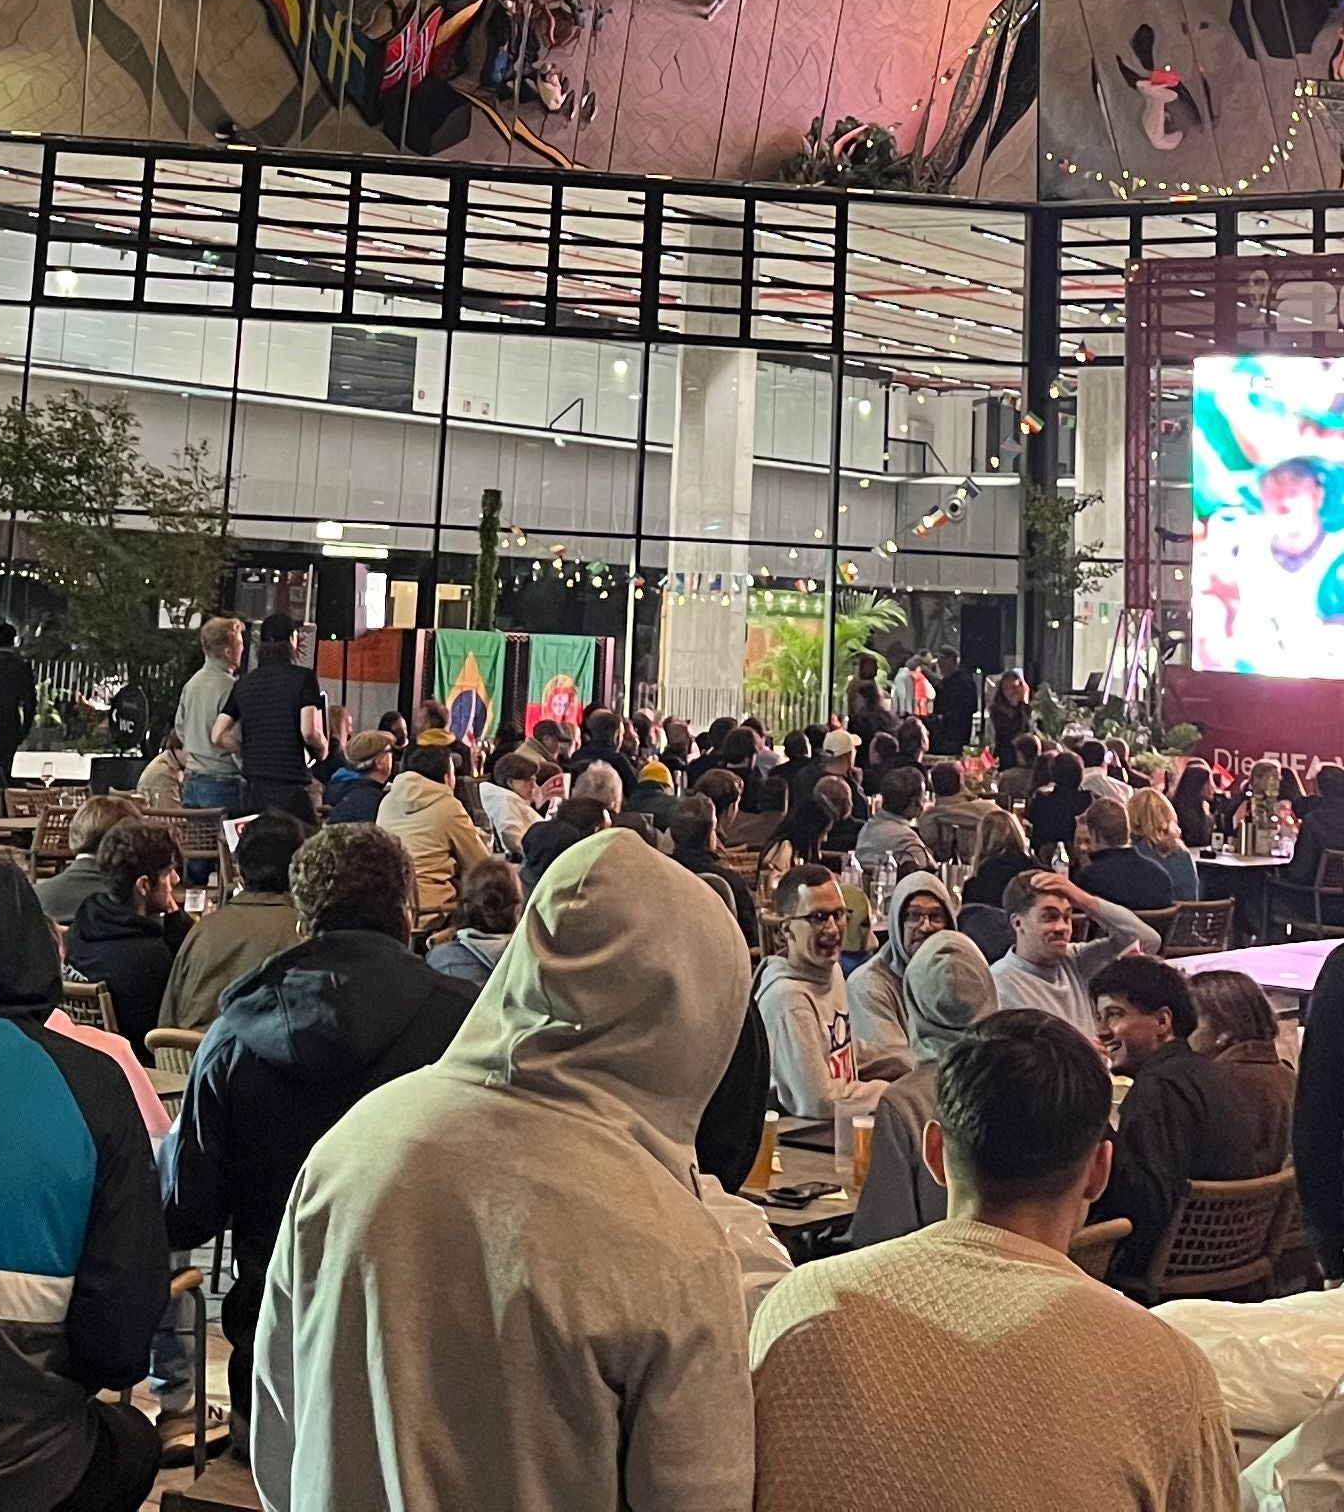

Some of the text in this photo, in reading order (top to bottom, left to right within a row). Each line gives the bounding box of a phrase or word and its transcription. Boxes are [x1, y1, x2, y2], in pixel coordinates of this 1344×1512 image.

[119, 718, 135, 734] WC
[1213, 748, 1253, 777] Die
[207, 1405, 224, 1421] N
